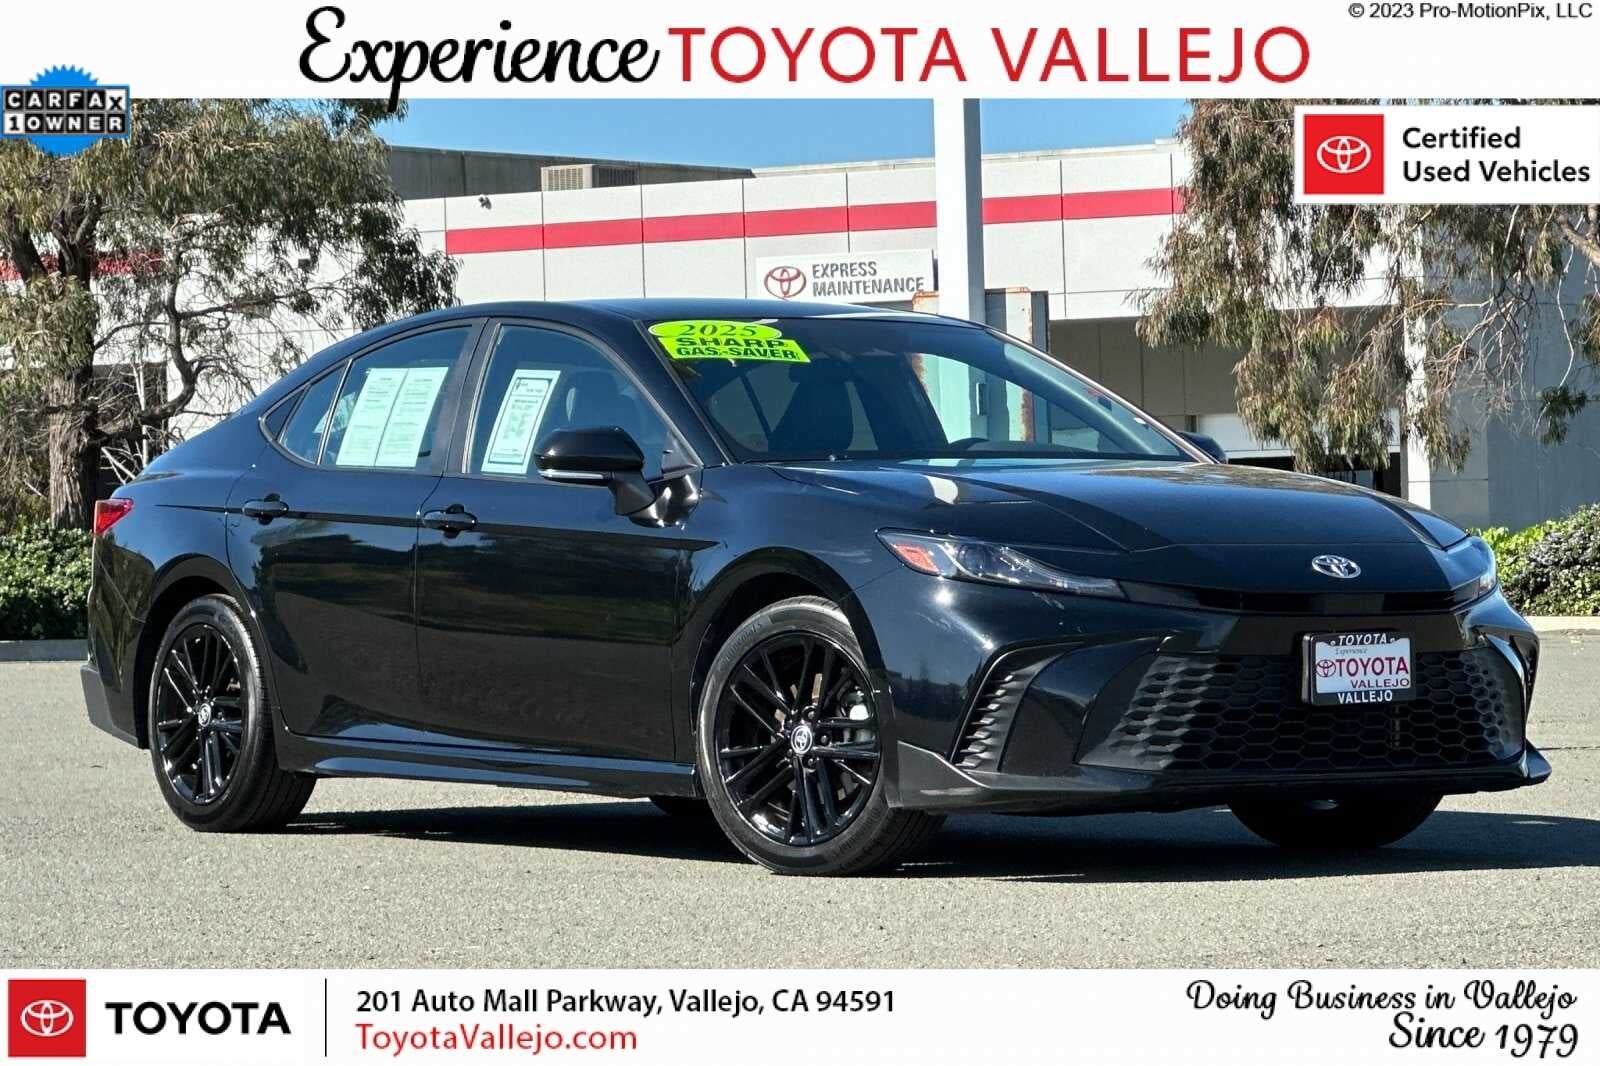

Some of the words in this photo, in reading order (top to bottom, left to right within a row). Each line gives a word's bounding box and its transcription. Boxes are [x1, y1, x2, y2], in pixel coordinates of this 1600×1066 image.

[812, 261, 877, 279] EXPRESS
[812, 277, 924, 297] MAINTENANCE
[679, 324, 758, 337] 2025
[676, 337, 785, 348] SHARP
[1338, 633, 1388, 646] TOYOTA
[1335, 656, 1410, 678] TOYOTA
[1350, 678, 1410, 689] VALLEJO
[1337, 690, 1393, 704] VALLEJO
